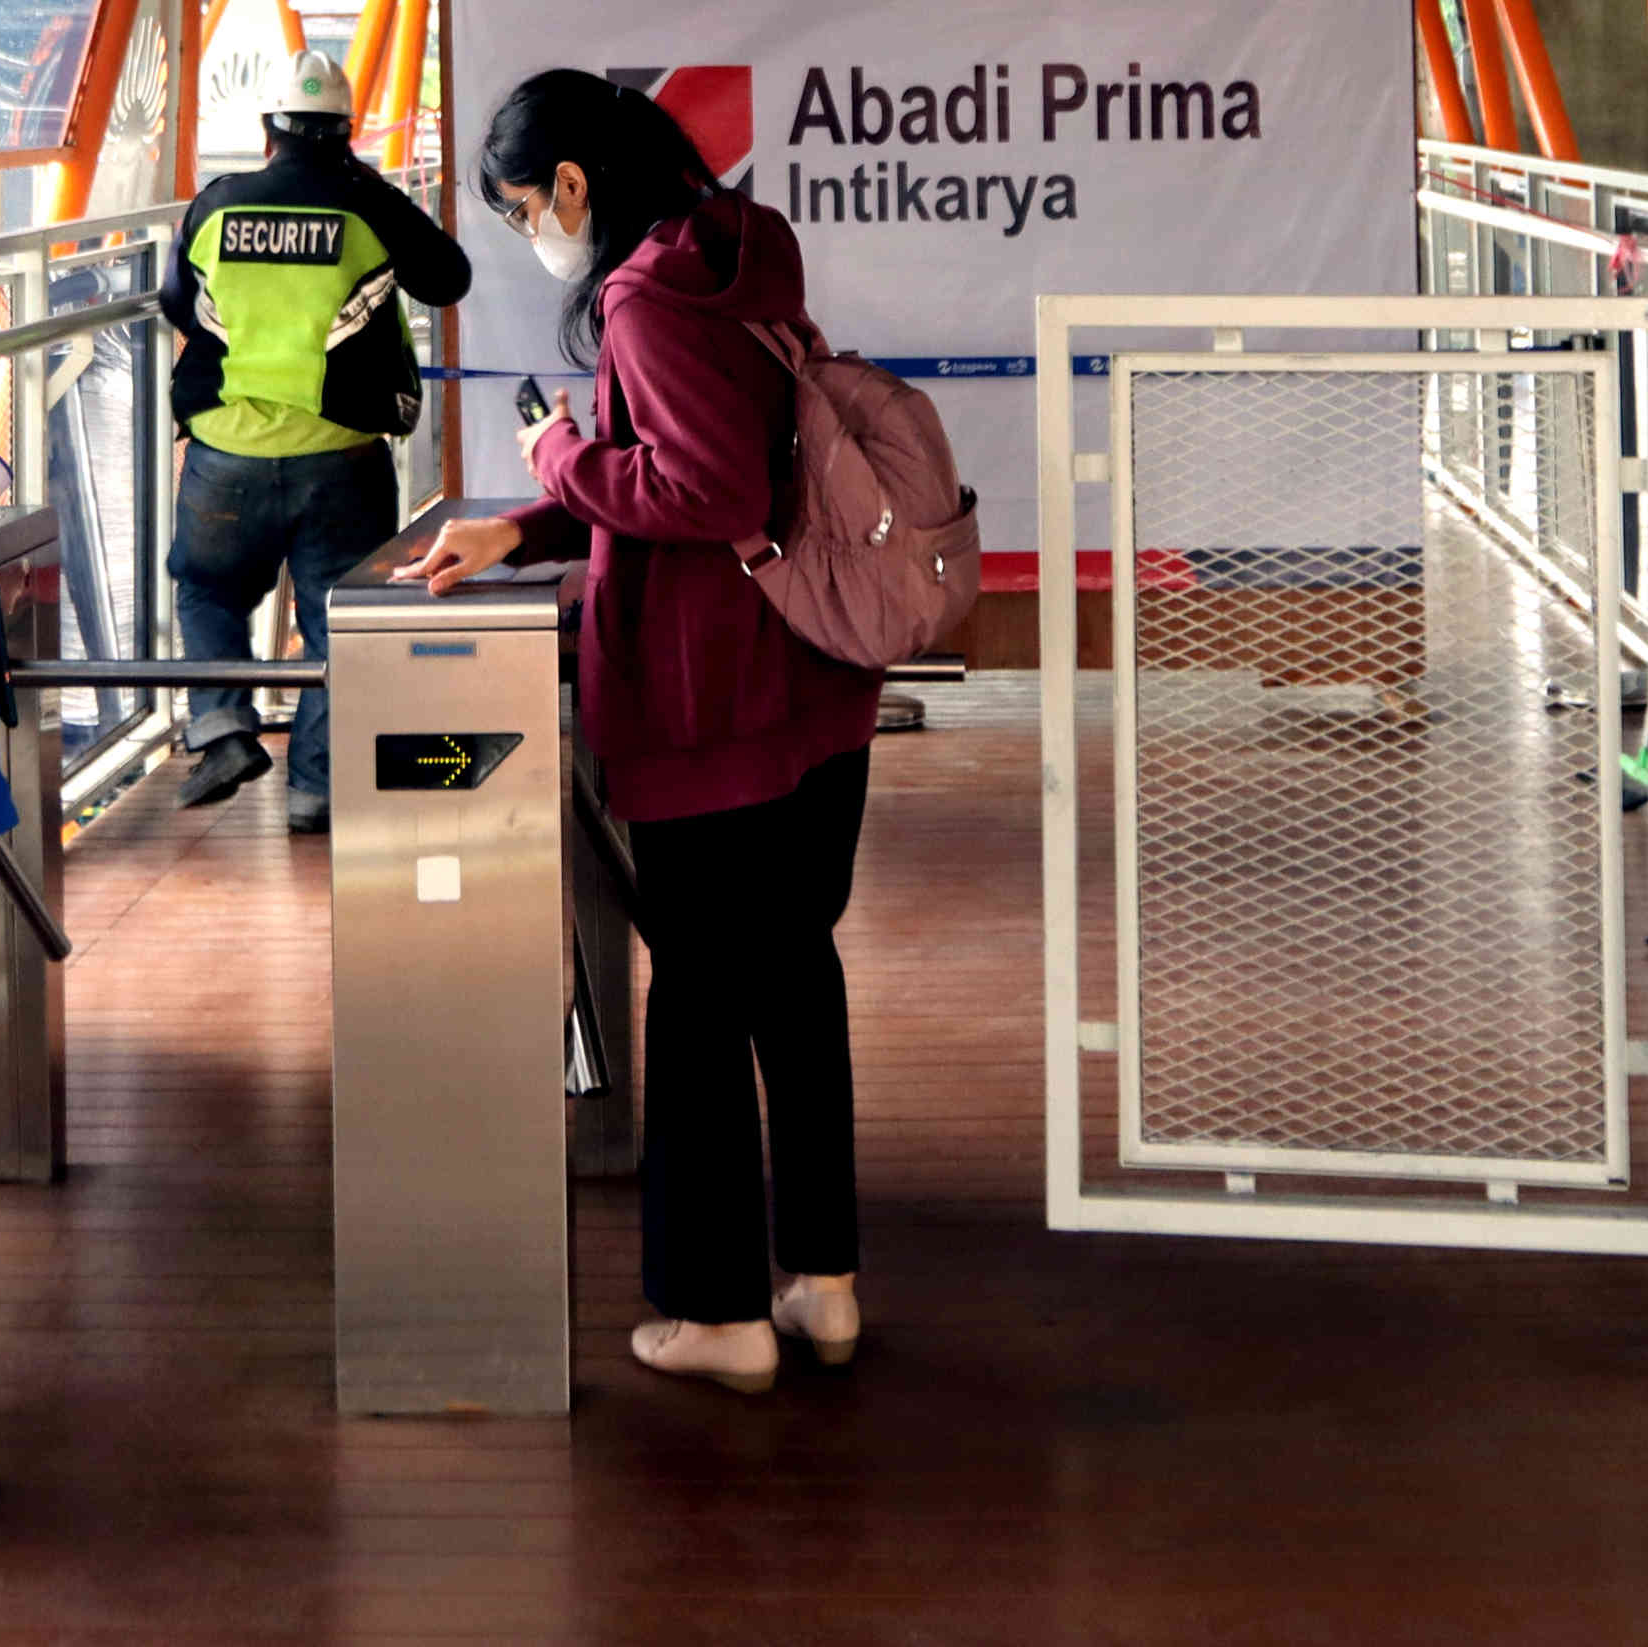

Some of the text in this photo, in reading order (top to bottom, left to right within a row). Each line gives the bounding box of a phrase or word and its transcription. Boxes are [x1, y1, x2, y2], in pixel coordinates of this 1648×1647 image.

[787, 61, 1263, 146] Abadi Prima
[224, 219, 340, 254] SECURITY
[788, 160, 1078, 238] Intikarya
